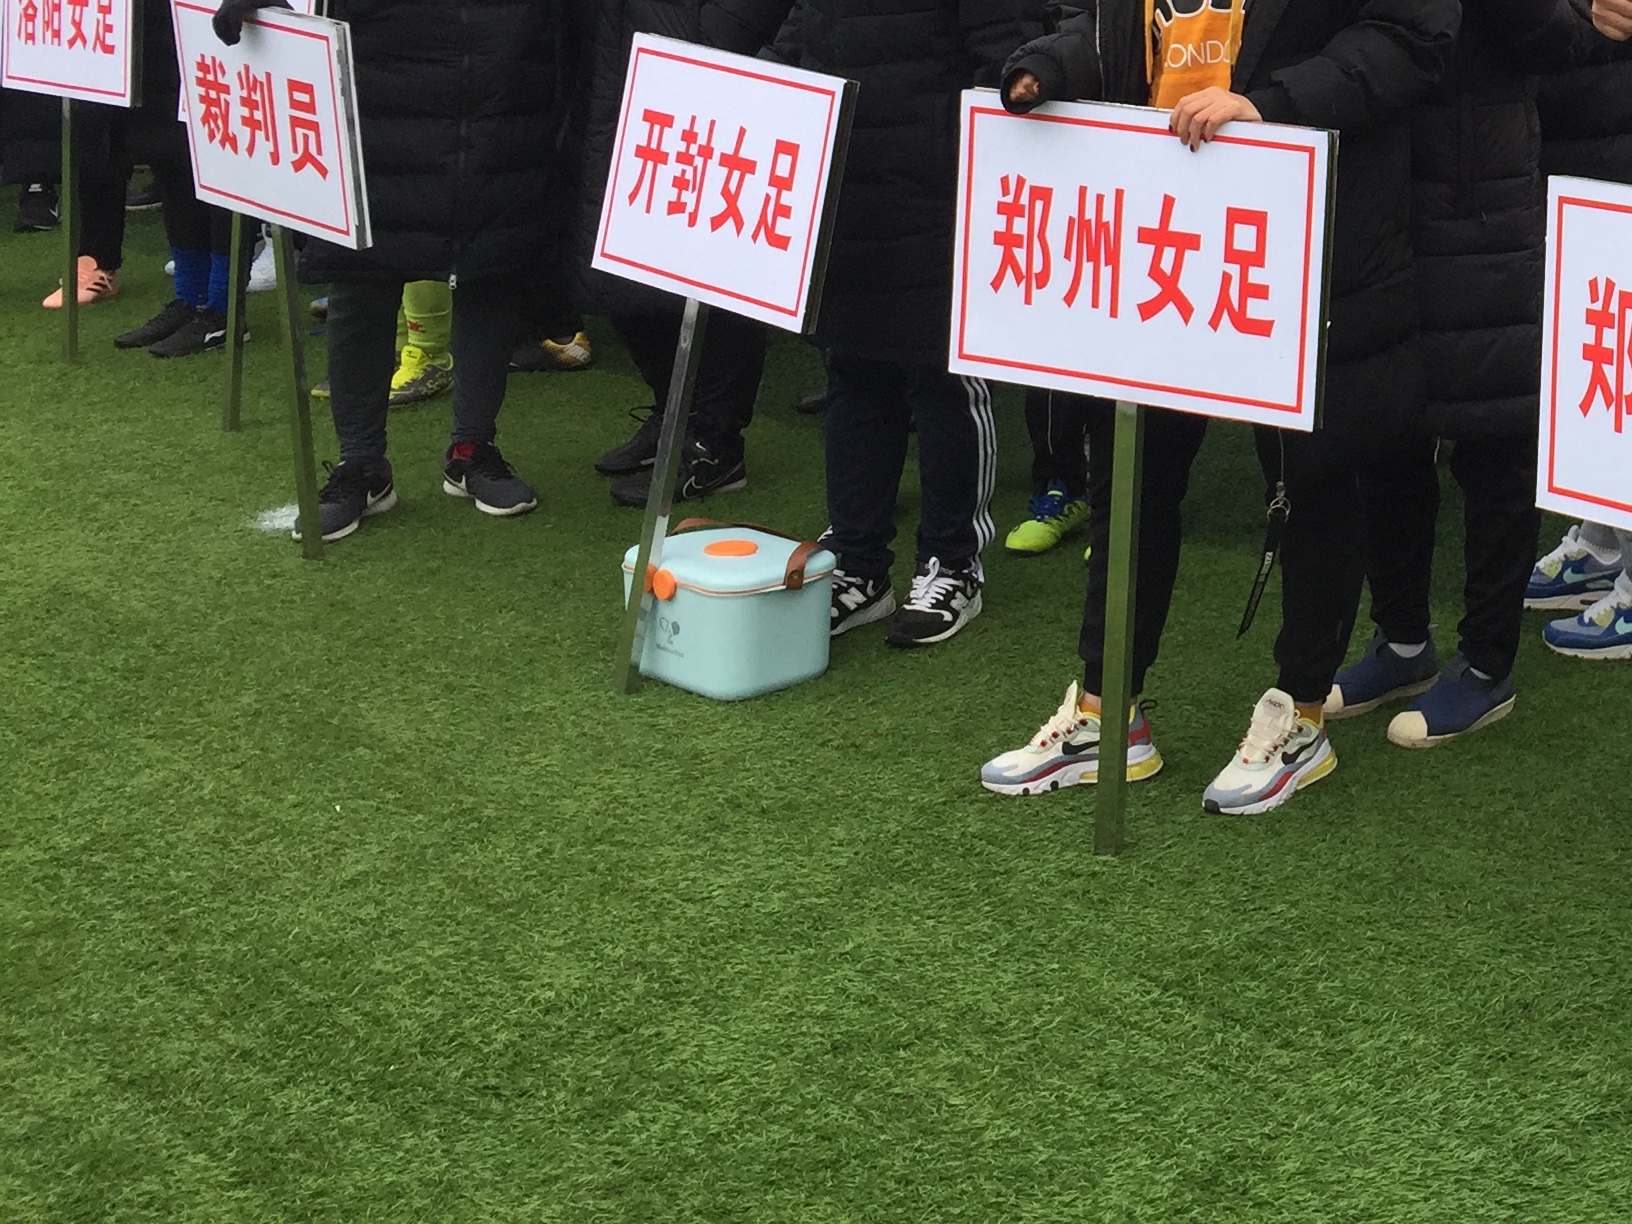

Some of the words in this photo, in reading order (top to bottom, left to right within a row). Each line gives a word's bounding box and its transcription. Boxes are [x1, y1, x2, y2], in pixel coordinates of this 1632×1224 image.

[195, 53, 329, 180] 裁判员
[628, 109, 800, 252] 开封女足
[990, 174, 1275, 338] 郑州女足
